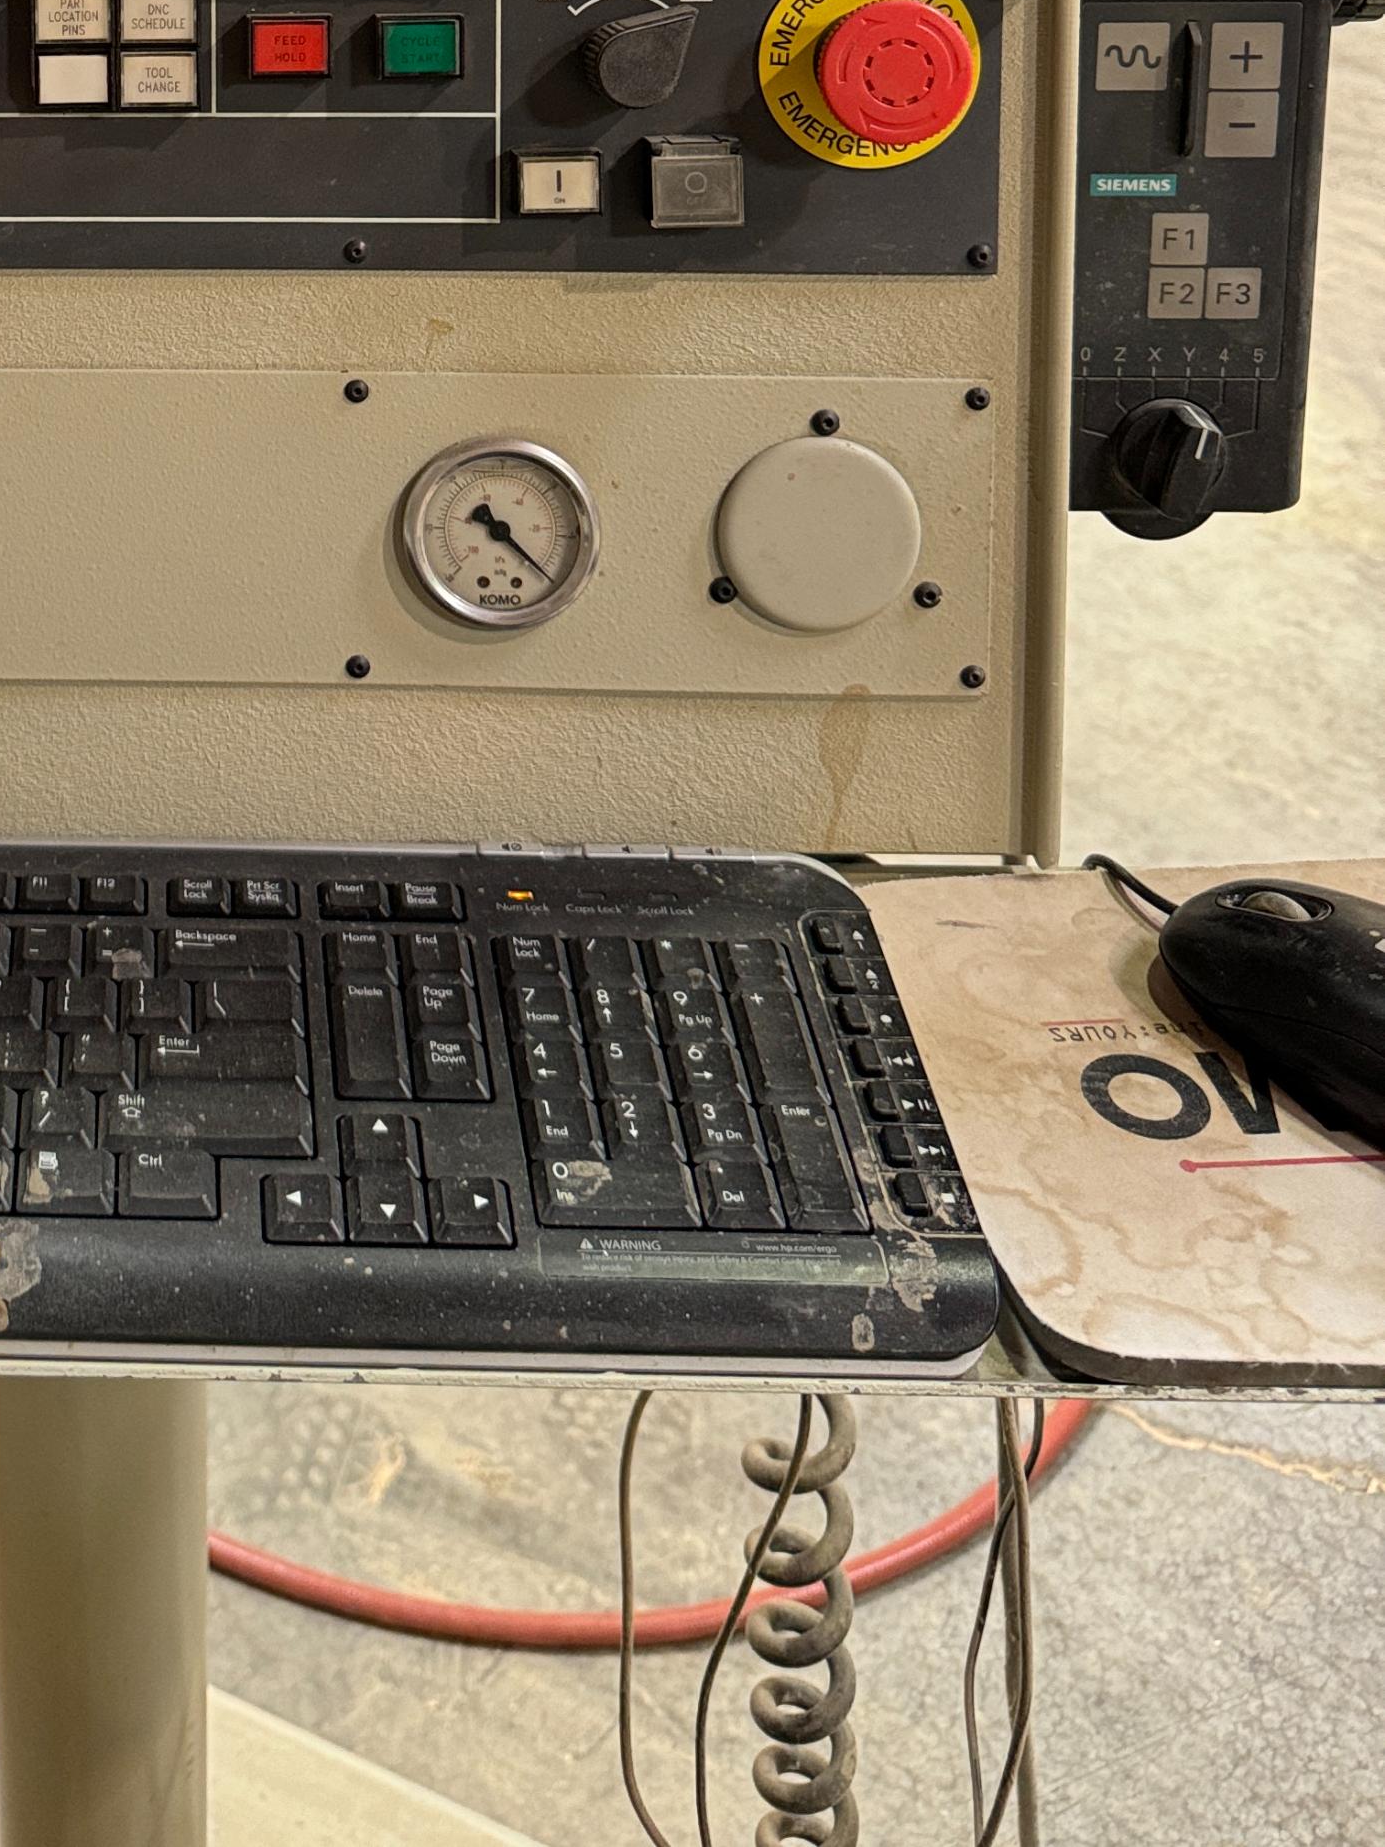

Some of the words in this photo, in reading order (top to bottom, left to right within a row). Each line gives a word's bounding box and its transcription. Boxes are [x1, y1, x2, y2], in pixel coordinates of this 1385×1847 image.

[147, 3, 169, 16] DNC
[48, 11, 99, 22] LOCATION
[131, 17, 186, 30] SCHEDULE
[62, 24, 86, 37] PINS
[274, 35, 307, 46] FEED
[274, 52, 307, 63] HOLD
[145, 67, 173, 79] TOOL
[137, 81, 181, 94] CHANGE
[1097, 179, 1171, 192] SIEMENS
[1159, 283, 1194, 305] F2
[1216, 283, 1251, 305] F3
[479, 594, 521, 605] KOMO
[175, 929, 237, 942] Backspace
[159, 1036, 190, 1047] Enter
[600, 1239, 661, 1251] WARNING
